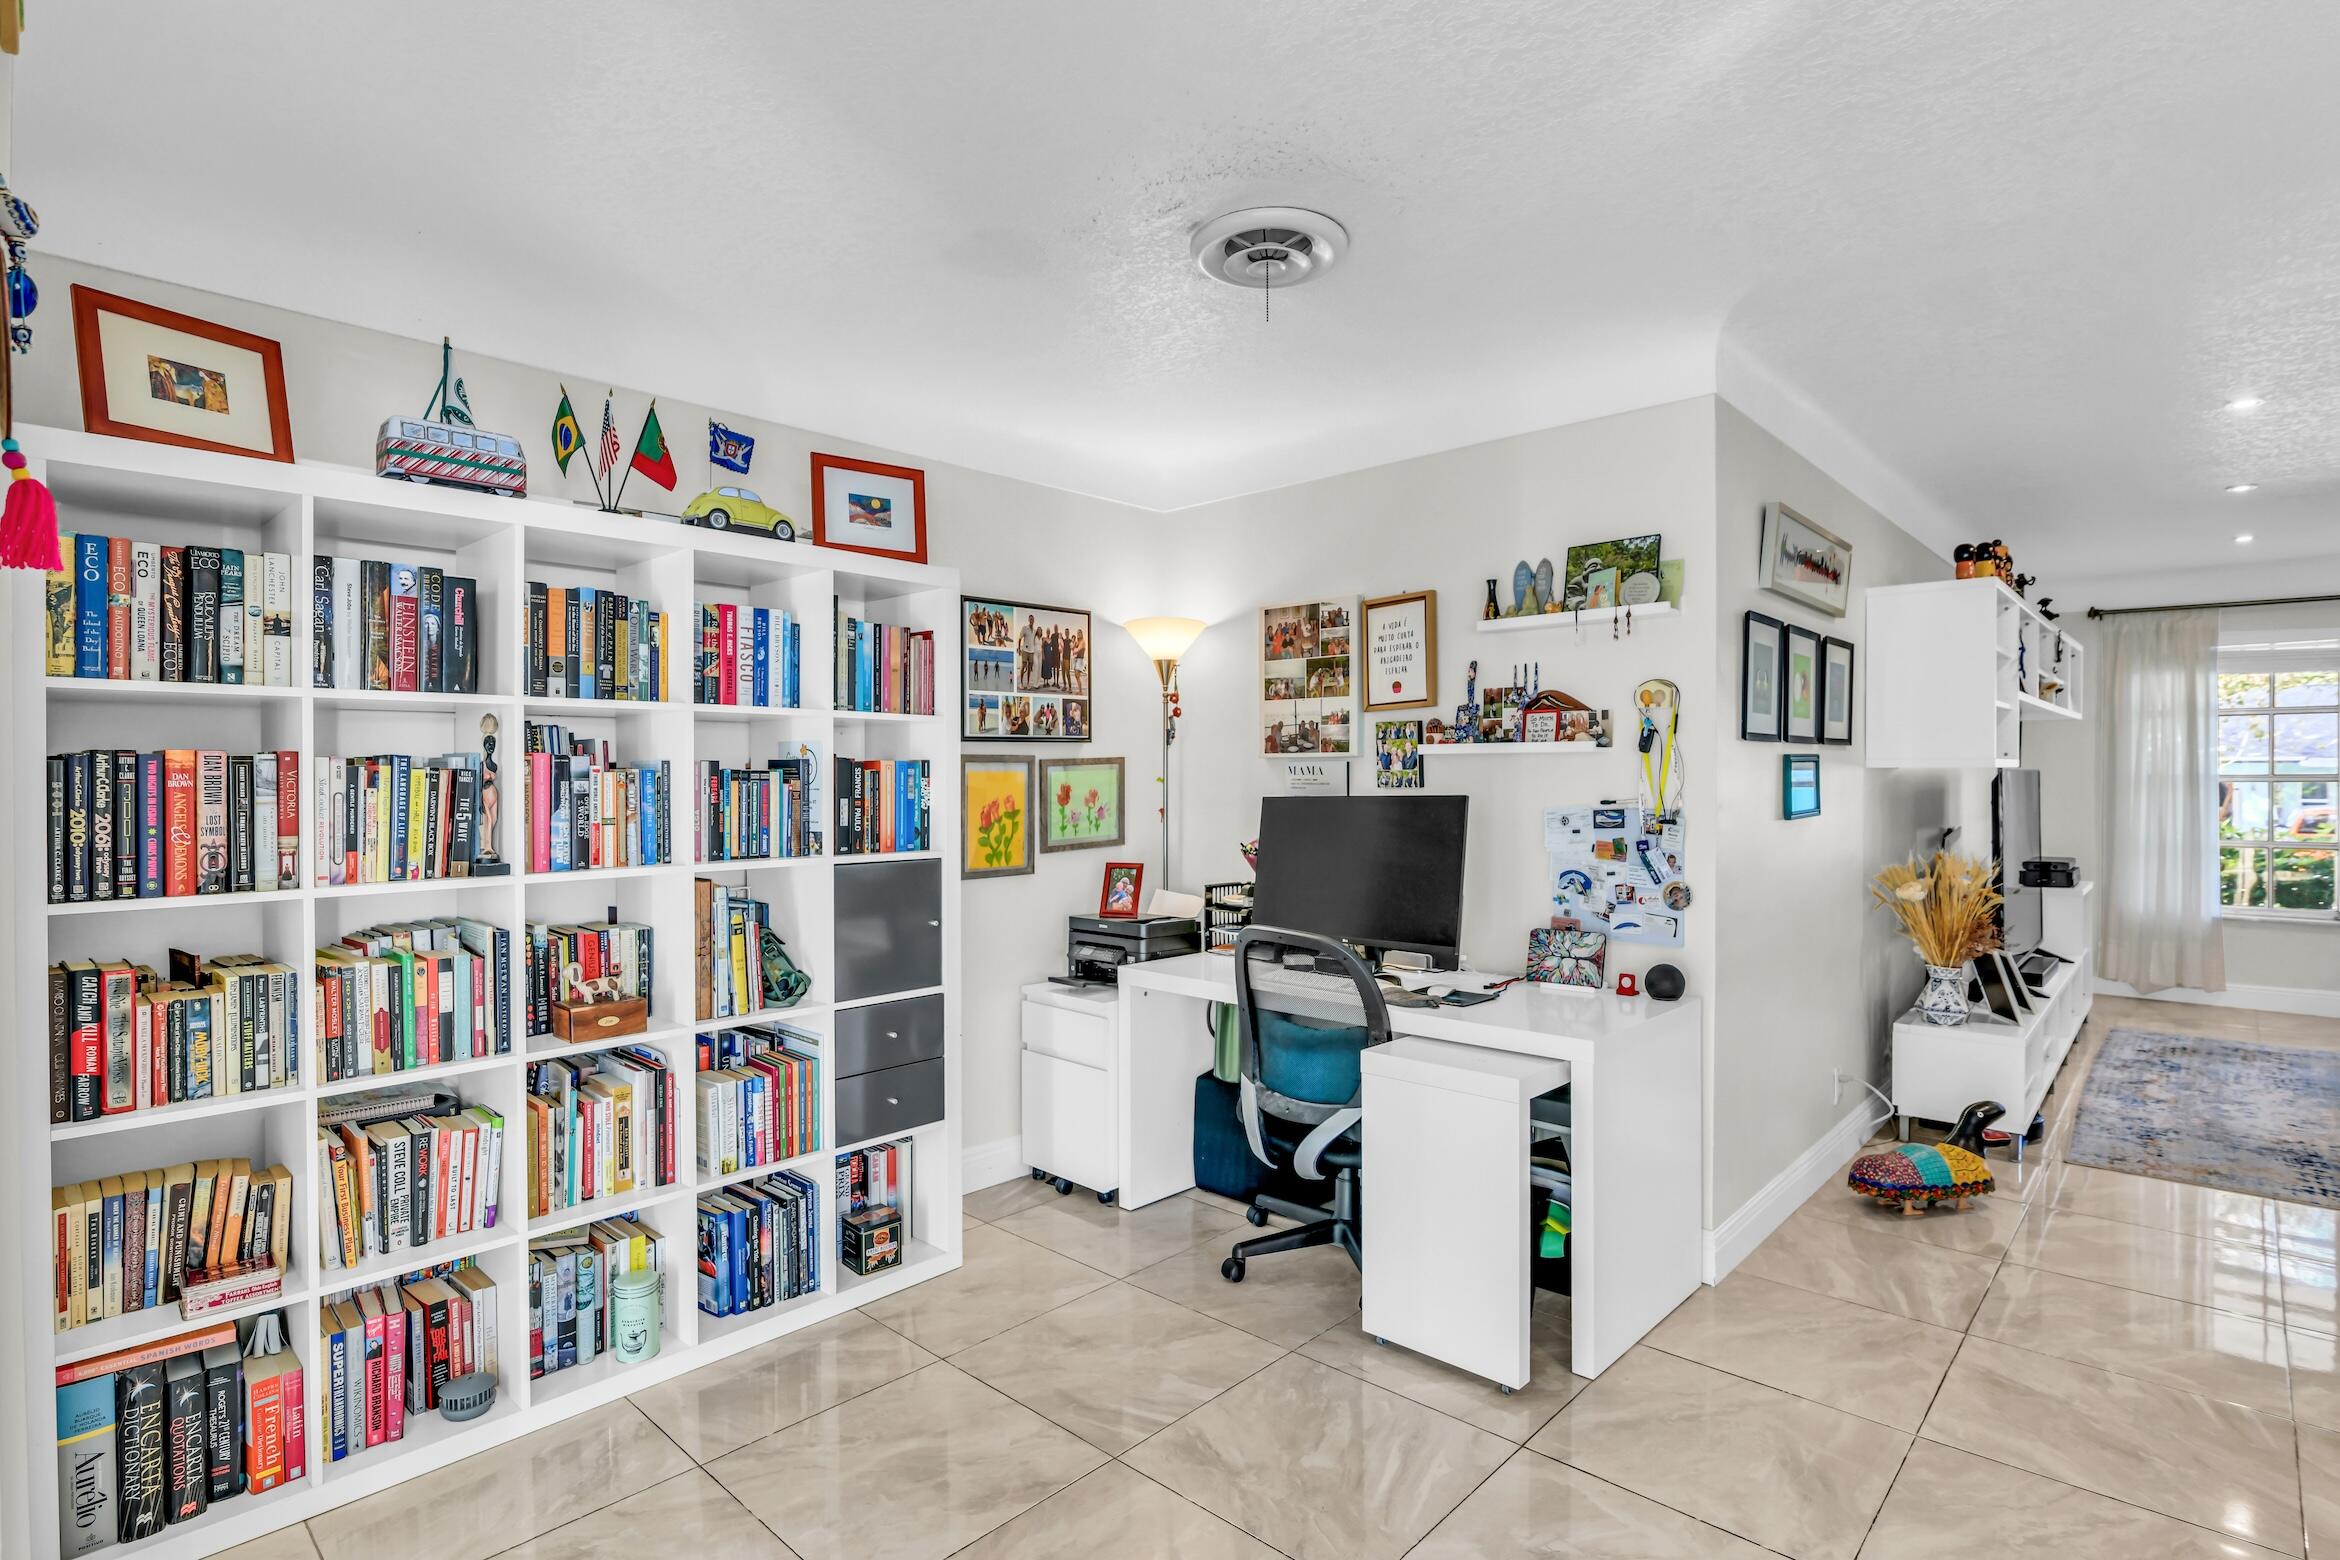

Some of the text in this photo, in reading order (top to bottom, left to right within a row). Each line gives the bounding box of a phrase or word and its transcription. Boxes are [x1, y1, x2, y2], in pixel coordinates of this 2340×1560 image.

[113, 566, 126, 592] ECO
[137, 551, 149, 578] ECO
[191, 557, 220, 570] ECO
[313, 565, 330, 633] Carl Sagan
[430, 574, 441, 611] CODE
[193, 592, 205, 640] PENDULUM
[115, 609, 124, 660] BAUDOLINO
[403, 602, 416, 673] EINSTEIN
[163, 641, 177, 672] ECO
[273, 640, 281, 672] CAPITAL
[740, 626, 754, 682] FIASCO
[147, 760, 157, 774] TWO
[167, 780, 194, 788] BROWN
[172, 772, 189, 781] DAN
[203, 754, 223, 805] DAN BROWN
[854, 767, 862, 799] FRANCIS
[286, 770, 298, 819] VICTORIA
[399, 773, 407, 810] LANGUAGE
[459, 797, 470, 812] THE
[70, 808, 86, 847] 2010:
[94, 813, 111, 852] 2061:
[200, 826, 225, 837] SYMBOL
[205, 815, 221, 826] LOST
[398, 822, 406, 838] LIFE
[399, 812, 406, 821] OF
[457, 822, 468, 843] WAVE
[577, 806, 585, 837] WORLD
[854, 807, 862, 832] PAULO
[587, 939, 596, 975] GENIUS
[271, 974, 283, 1003] FEMINISM
[77, 976, 98, 1042] CATCH AND KILL
[258, 997, 266, 1033] LABYRINTHS
[243, 1021, 253, 1070] STUFF MATTERS
[77, 1046, 97, 1105] RONAN FARROW
[726, 1097, 735, 1153] SHANTARAM
[337, 1165, 346, 1181] Your
[417, 1137, 429, 1177] REWORK
[339, 1183, 347, 1196] First
[394, 1141, 410, 1224] STEVE COLL PRIVATE
[450, 1185, 456, 1193] TO
[177, 1198, 186, 1223] CRIME
[340, 1197, 351, 1239] Business
[390, 1198, 399, 1225] EMPIRE
[175, 1224, 184, 1238] AND
[139, 1337, 216, 1361] SPANISH WORDS
[332, 1342, 345, 1436] SUPERFREAKONOMICS
[371, 1360, 382, 1431] RICHARD BRANSON
[292, 1404, 303, 1439] Latin
[352, 1378, 363, 1439] WIKINOMICS
[209, 1407, 218, 1449] THESAURUS
[218, 1430, 231, 1461] CENTURY
[264, 1403, 281, 1466] French
[124, 1407, 141, 1501] DICTIONARY
[139, 1399, 161, 1500] ENCARTA
[168, 1416, 186, 1491] QUOTATIONS
[185, 1410, 203, 1489] ENCARTA
[74, 1451, 108, 1529] Aurélio
